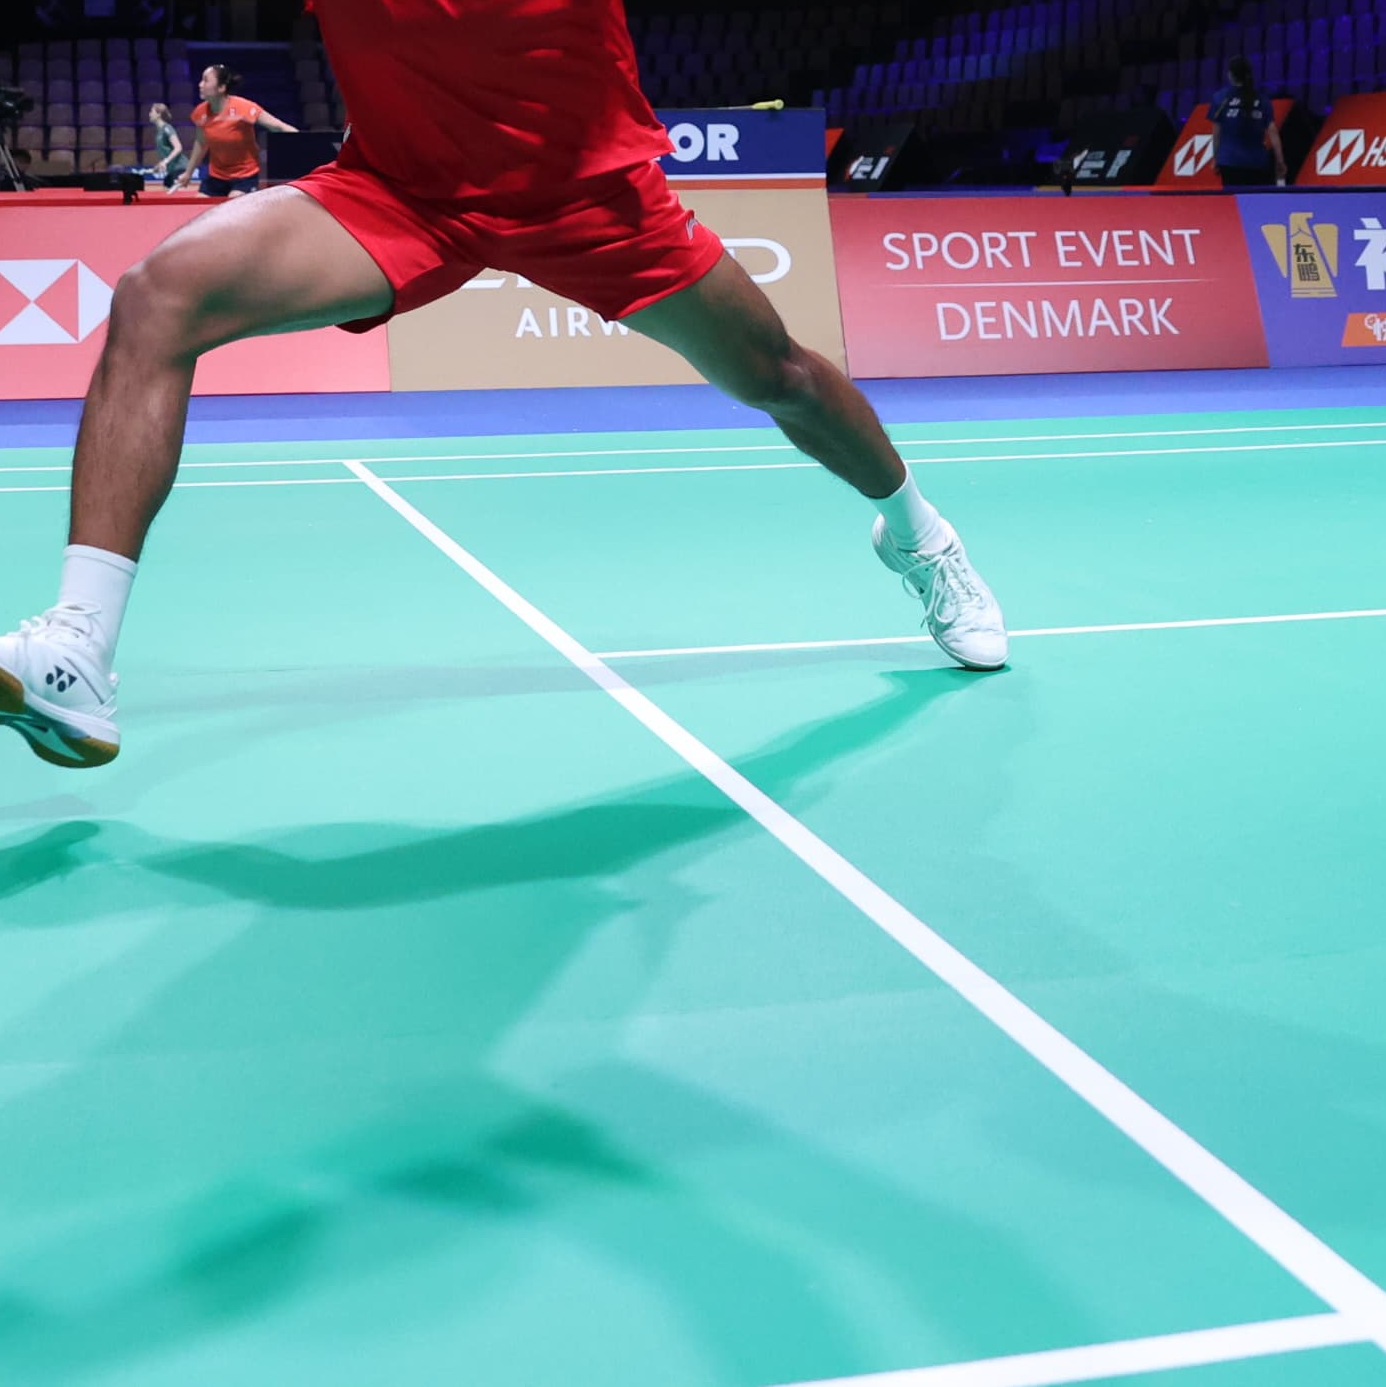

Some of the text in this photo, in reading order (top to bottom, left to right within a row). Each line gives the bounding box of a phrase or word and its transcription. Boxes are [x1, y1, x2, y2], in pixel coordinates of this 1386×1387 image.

[882, 228, 1202, 271] SPORT EVENT
[935, 297, 1182, 342] DENMARK
